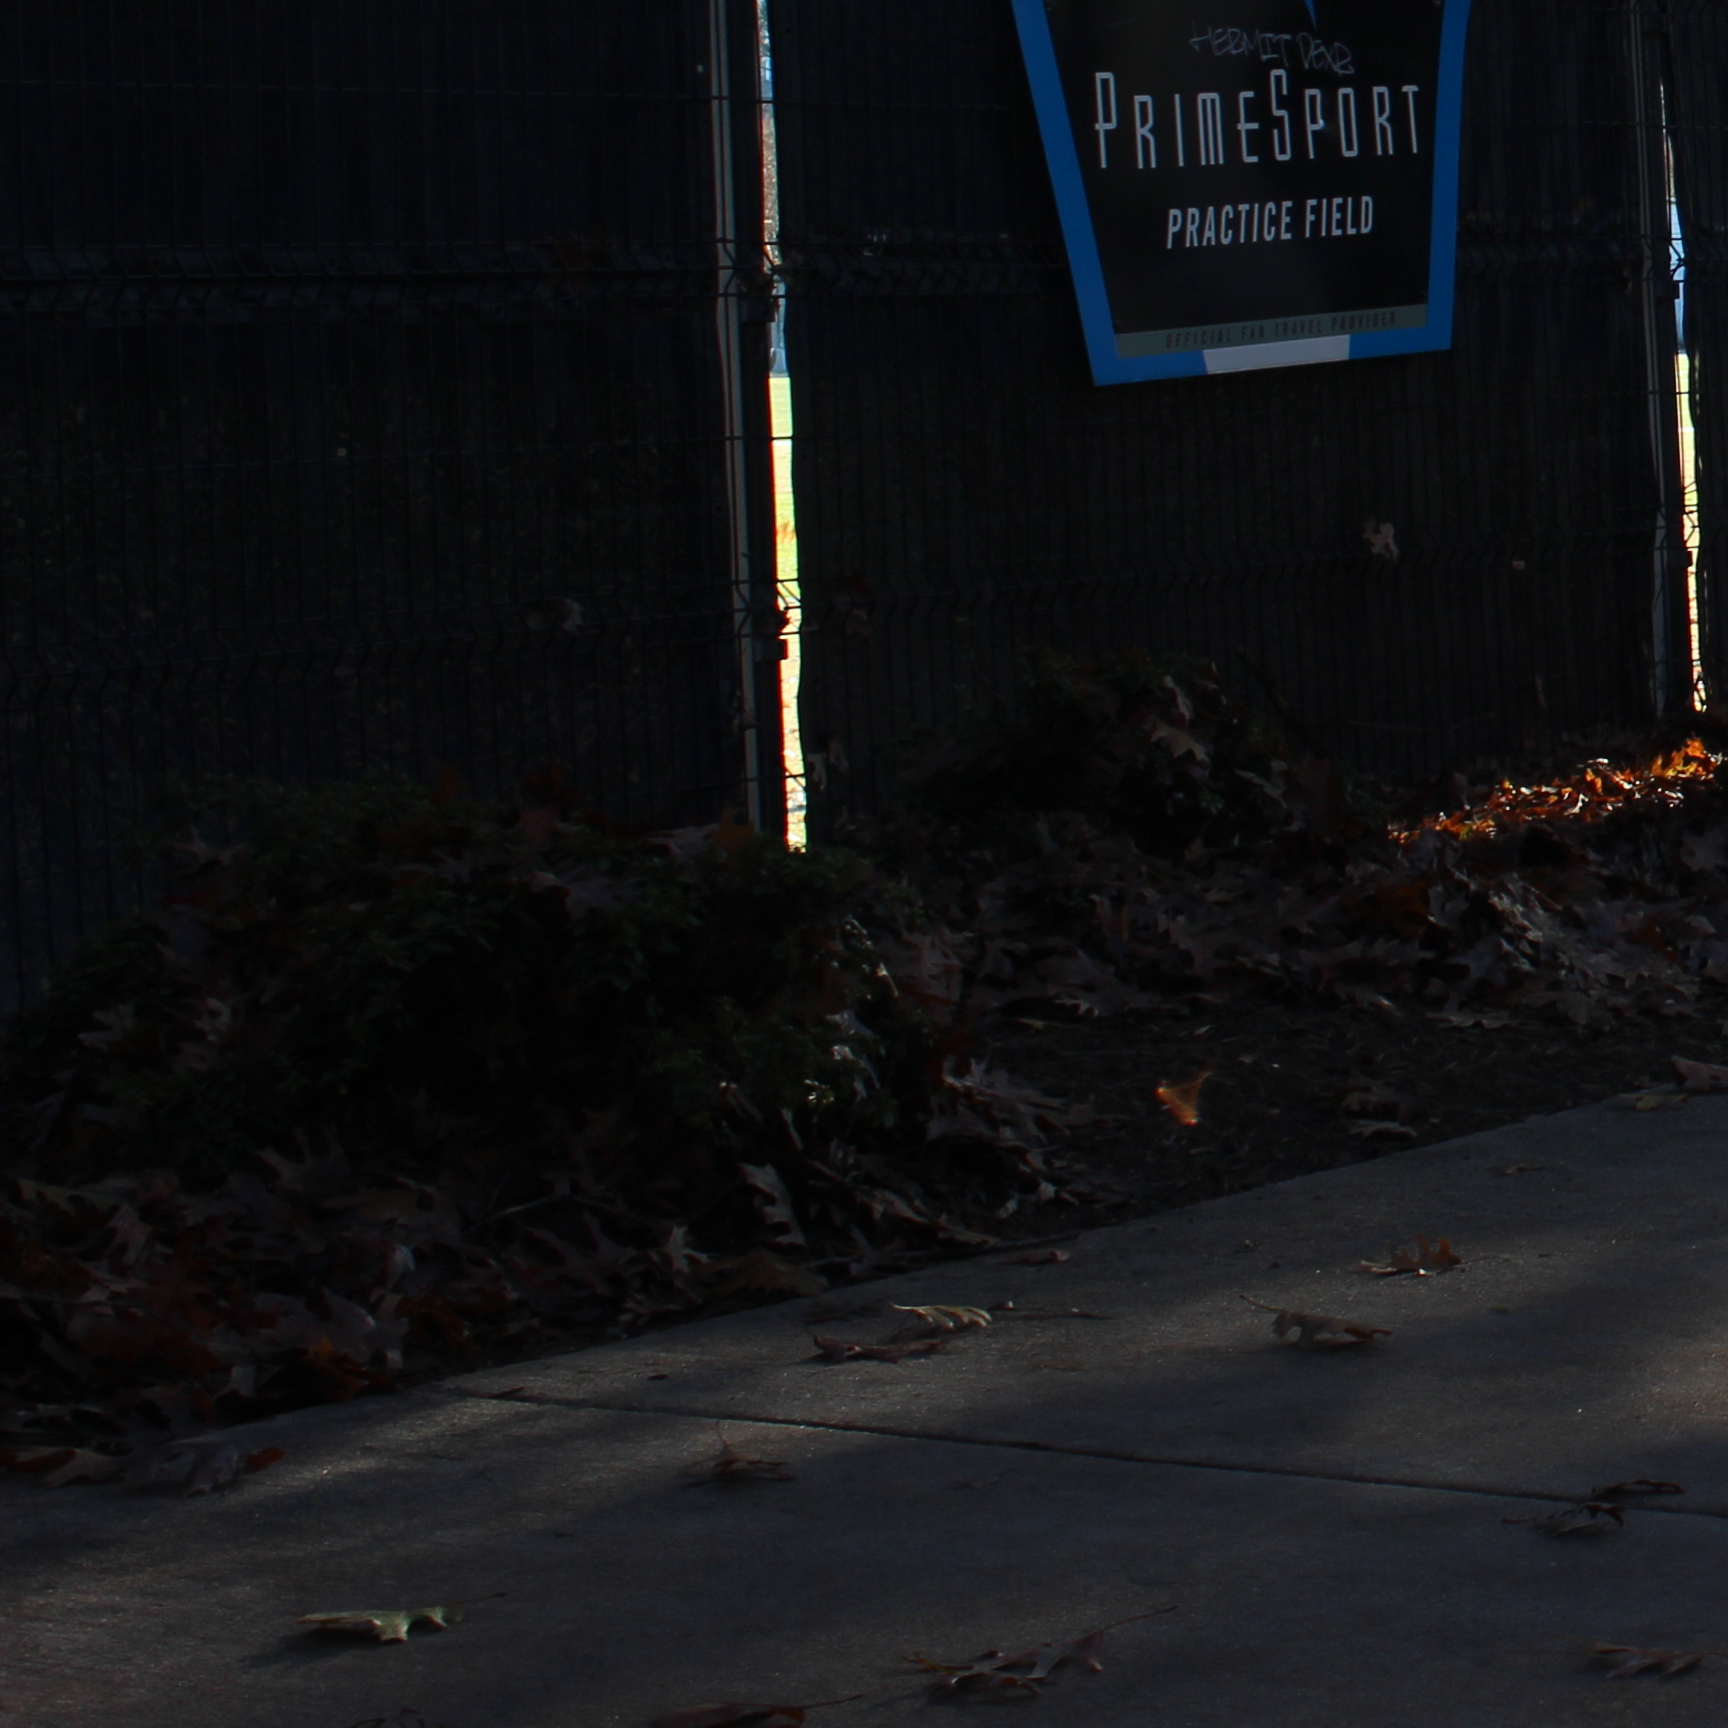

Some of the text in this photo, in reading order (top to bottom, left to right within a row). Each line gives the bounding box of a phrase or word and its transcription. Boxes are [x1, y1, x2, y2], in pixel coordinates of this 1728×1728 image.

[1167, 195, 1374, 249] PRACTICE FIELD
[1166, 310, 1397, 349] OFFICIAL FAN TRAVEL PROVIDER
